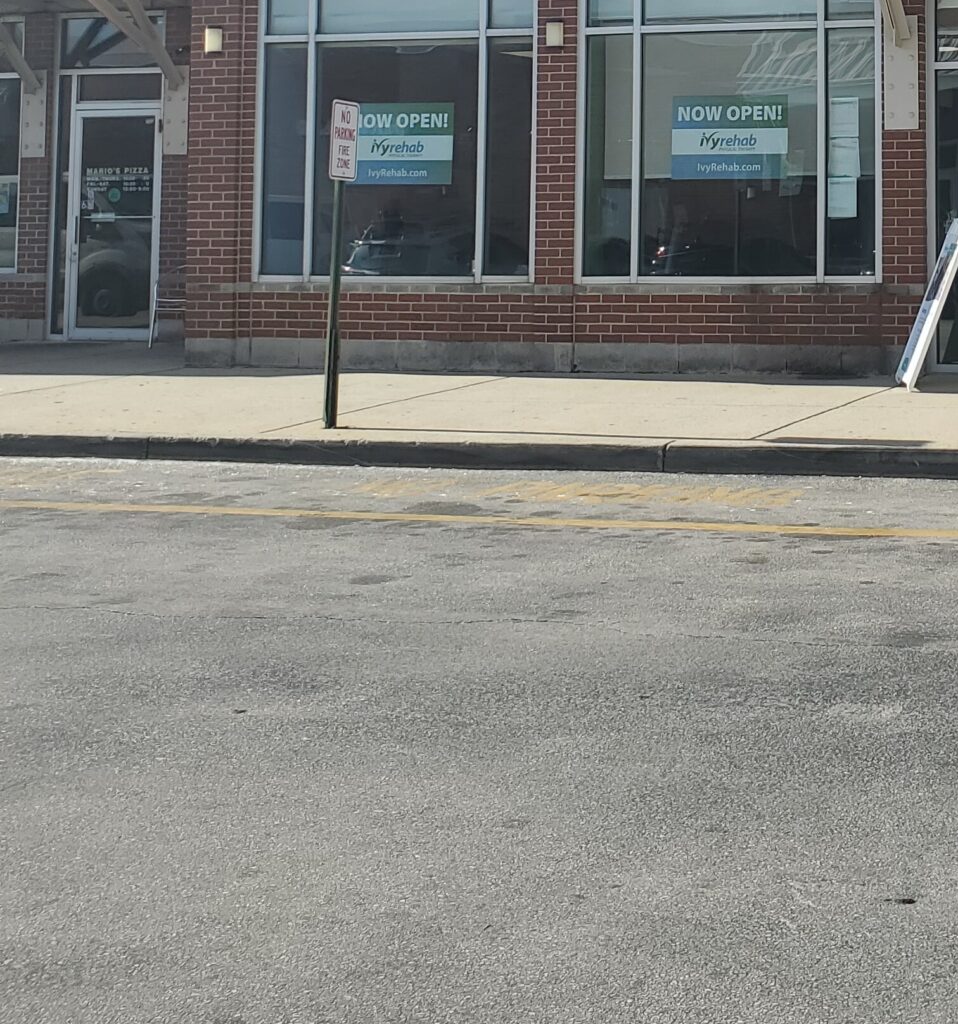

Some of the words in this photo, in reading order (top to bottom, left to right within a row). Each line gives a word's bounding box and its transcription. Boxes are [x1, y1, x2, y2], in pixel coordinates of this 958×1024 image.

[341, 110, 351, 125] NO
[677, 106, 722, 122] NOW
[726, 105, 783, 121] OPEN!
[396, 113, 449, 129] OPEN!
[335, 127, 356, 142] PARKING
[338, 145, 351, 156] FIRE
[336, 158, 351, 169] ZONE
[697, 162, 761, 173] IvyRehab.com
[368, 168, 428, 180] IvyRehab.com
